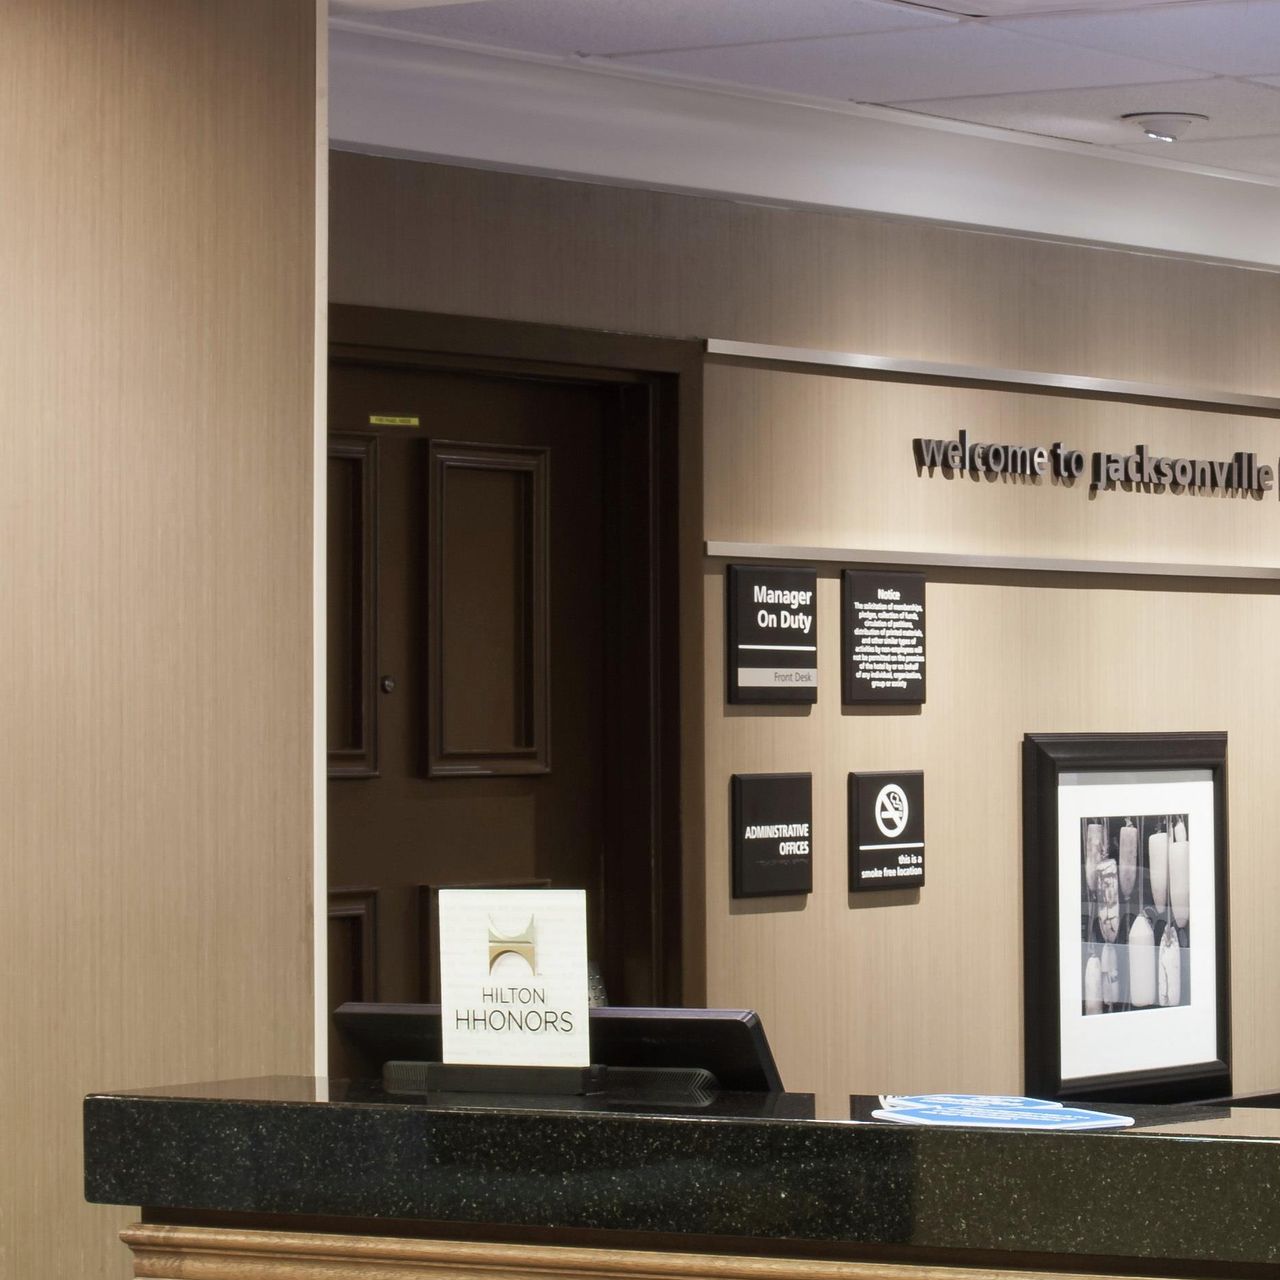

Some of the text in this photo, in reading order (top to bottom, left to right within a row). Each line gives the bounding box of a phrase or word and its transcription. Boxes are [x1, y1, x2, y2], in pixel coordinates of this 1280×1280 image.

[913, 430, 1049, 480] welcome
[1052, 442, 1086, 480] to
[1089, 445, 1274, 495] jacksonville
[754, 585, 813, 609] Manager
[877, 588, 901, 601] Notice
[757, 610, 812, 634] On Duty
[774, 672, 813, 682] Front Desk
[745, 823, 809, 840] ADMINISTRATIVE
[779, 841, 809, 856] OFFICES
[898, 854, 922, 864] this is a
[861, 865, 922, 879] smoke free location
[482, 987, 545, 1005] HILTON
[455, 1009, 574, 1033] HHONORS
